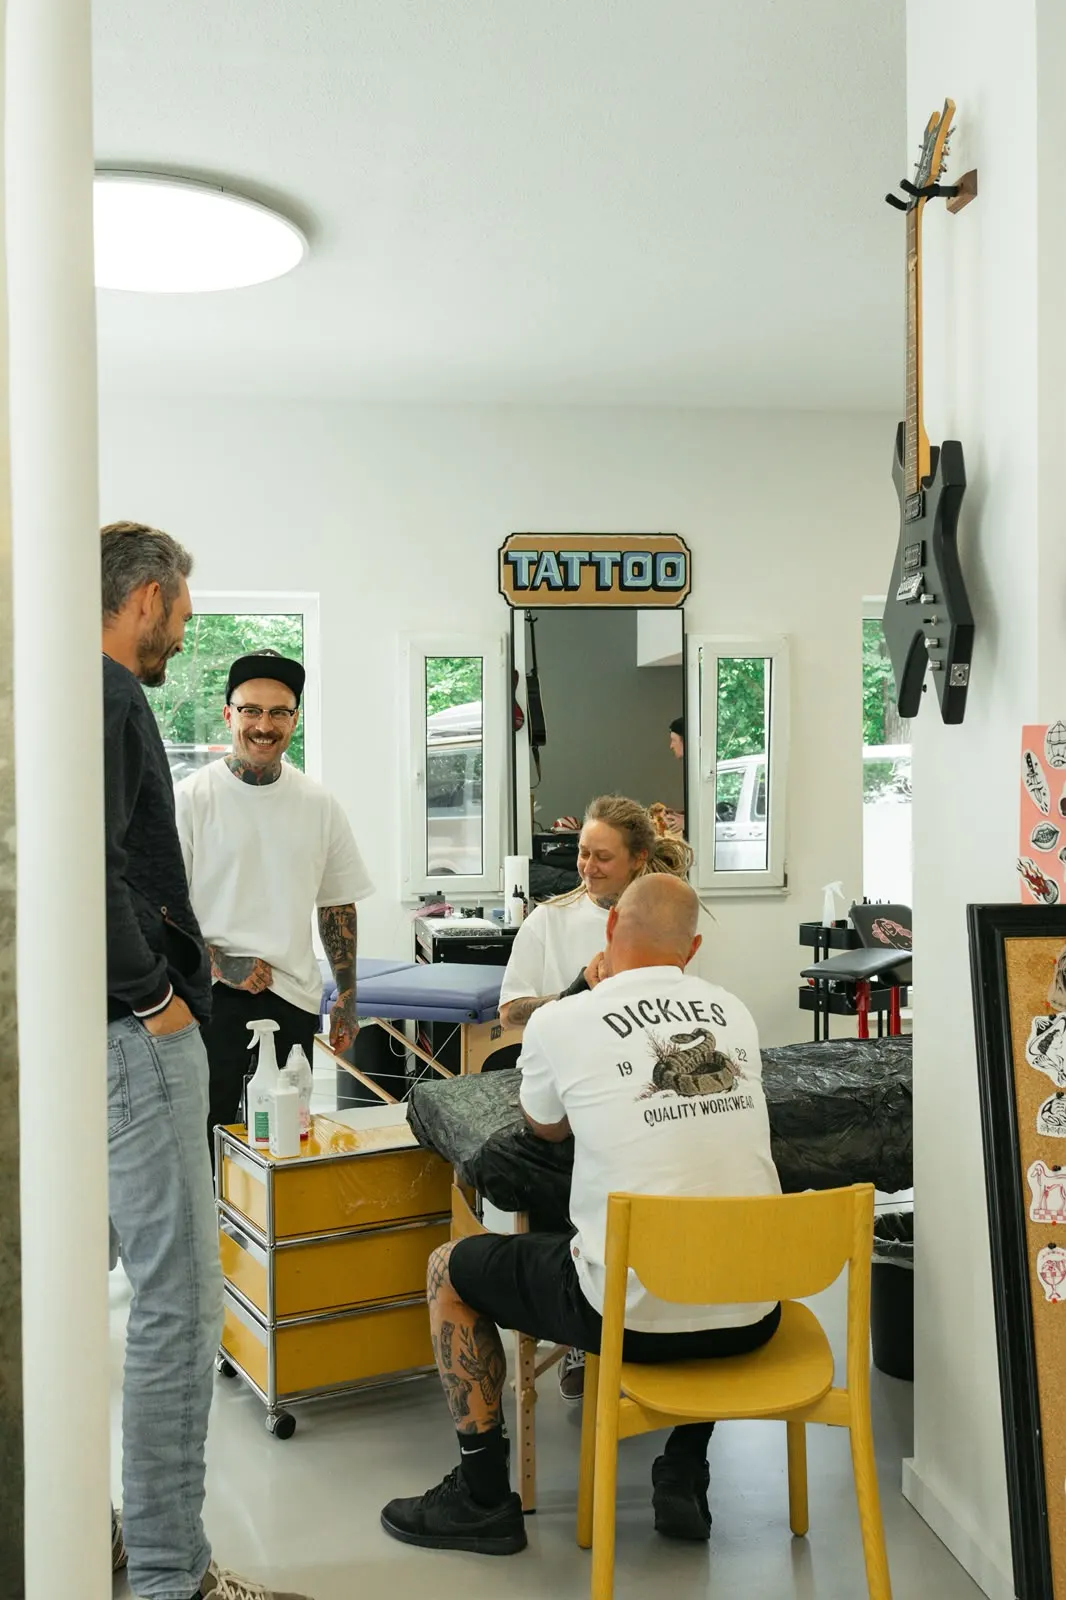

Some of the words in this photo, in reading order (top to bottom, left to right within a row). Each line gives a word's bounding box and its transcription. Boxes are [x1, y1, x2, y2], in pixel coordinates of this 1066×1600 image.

[505, 550, 687, 592] TATTOO
[602, 998, 727, 1039] DICKIES
[615, 1060, 633, 1077] 19
[734, 1047, 748, 1062] 22
[643, 1102, 697, 1127] QUALITY
[699, 1095, 755, 1116] WORKWEAR
